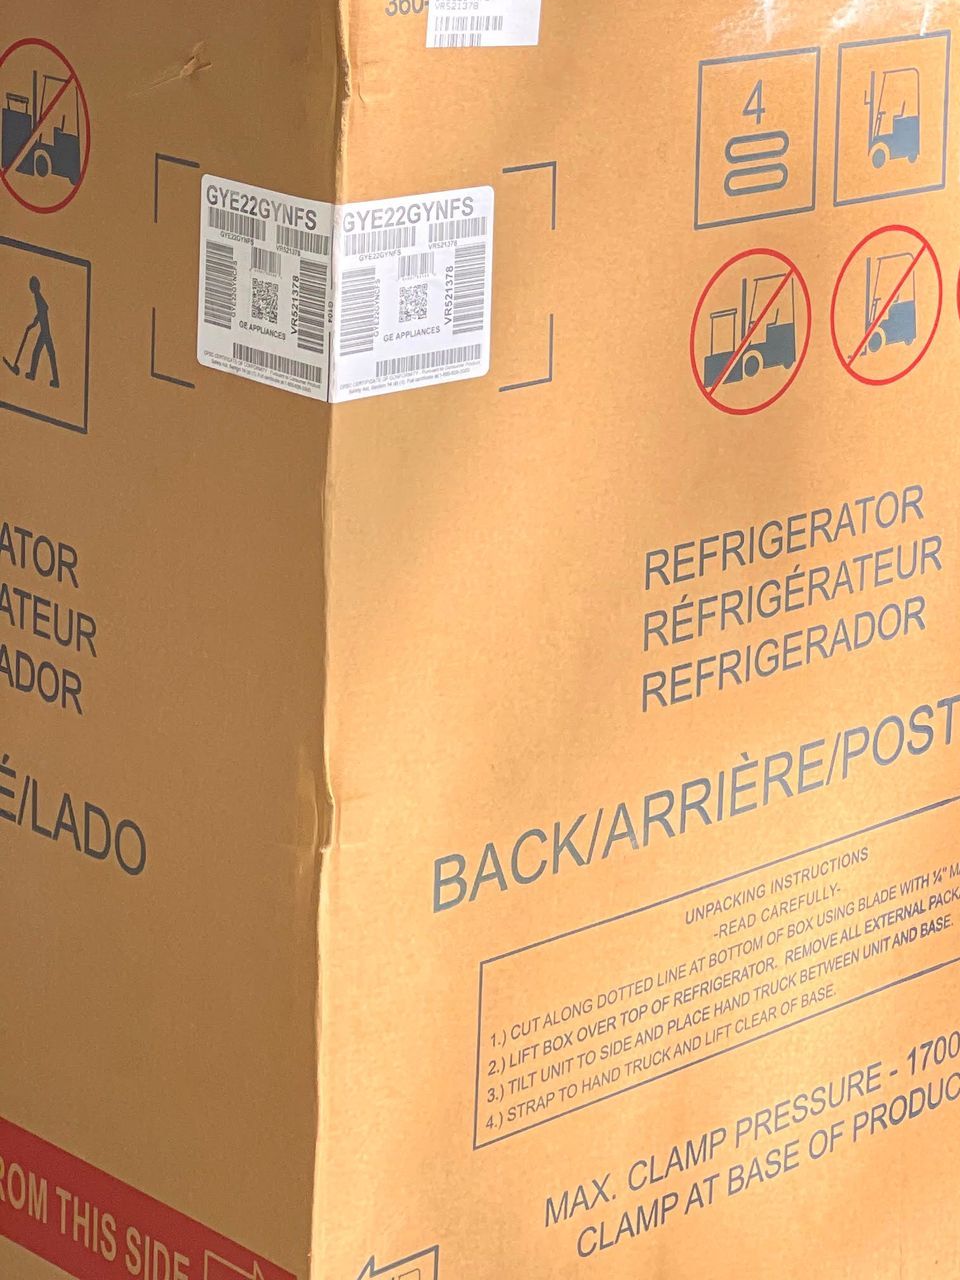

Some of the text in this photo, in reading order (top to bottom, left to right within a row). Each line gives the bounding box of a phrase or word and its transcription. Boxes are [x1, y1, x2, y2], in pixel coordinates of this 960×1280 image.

[742, 79, 766, 125] 4
[206, 184, 317, 231] GYE22GYNFS
[343, 196, 474, 233] GYE22GYNFS
[239, 320, 287, 341] GE APPLIANCES
[383, 326, 440, 342] GE APPLIANCES
[644, 484, 925, 590] REFRIGERATOR
[643, 535, 943, 651] RÉFRIGÉRATEUR
[641, 596, 926, 713] REFRIGERADOR
[685, 846, 869, 924] UNPACKING INSTRUCTIONS
[487, 913, 954, 1104] 3.) TILT UNIT TO SIDE AND PLACE HAND TRUCK BETWEEN UNIT AND BASE.
[488, 1057, 505, 1077] 2.)
[509, 1043, 541, 1069] LIFT
[542, 1033, 574, 1058] BOX
[577, 1016, 617, 1043] OVER
[620, 1004, 648, 1029] TOP
[651, 996, 671, 1015] OF
[673, 956, 778, 1008] REFRIGERATOR.
[785, 934, 838, 966] REMOVE
[840, 925, 862, 944] ALL
[864, 900, 926, 934] EXTERNAL
[490, 1028, 506, 1048] 1.)
[510, 1016, 540, 1041] CUT
[543, 998, 593, 1029] ALONG
[597, 976, 653, 1013] DOTTED
[657, 963, 687, 988] LINE
[689, 957, 706, 976] AT
[708, 935, 763, 970] BOTTOM
[766, 928, 785, 947] OF
[787, 918, 814, 939] BOX
[816, 903, 855, 929] USING
[858, 885, 897, 912] BLADE
[900, 872, 930, 896] WITH
[486, 982, 837, 1131] 4.) STRAP TO HAND TRUCK AND LIFT CLEAR OF BASE.
[544, 1174, 616, 1228] MAX.
[627, 1128, 728, 1193] CLAMP
[735, 1061, 883, 1149] PRESSURE
[906, 1031, 960, 1077] 1700
[56, 1186, 117, 1262] THIS
[576, 1190, 679, 1260] CLAMP
[684, 1176, 720, 1215] AT
[726, 1140, 800, 1197] BASE
[808, 1126, 845, 1161] OF
